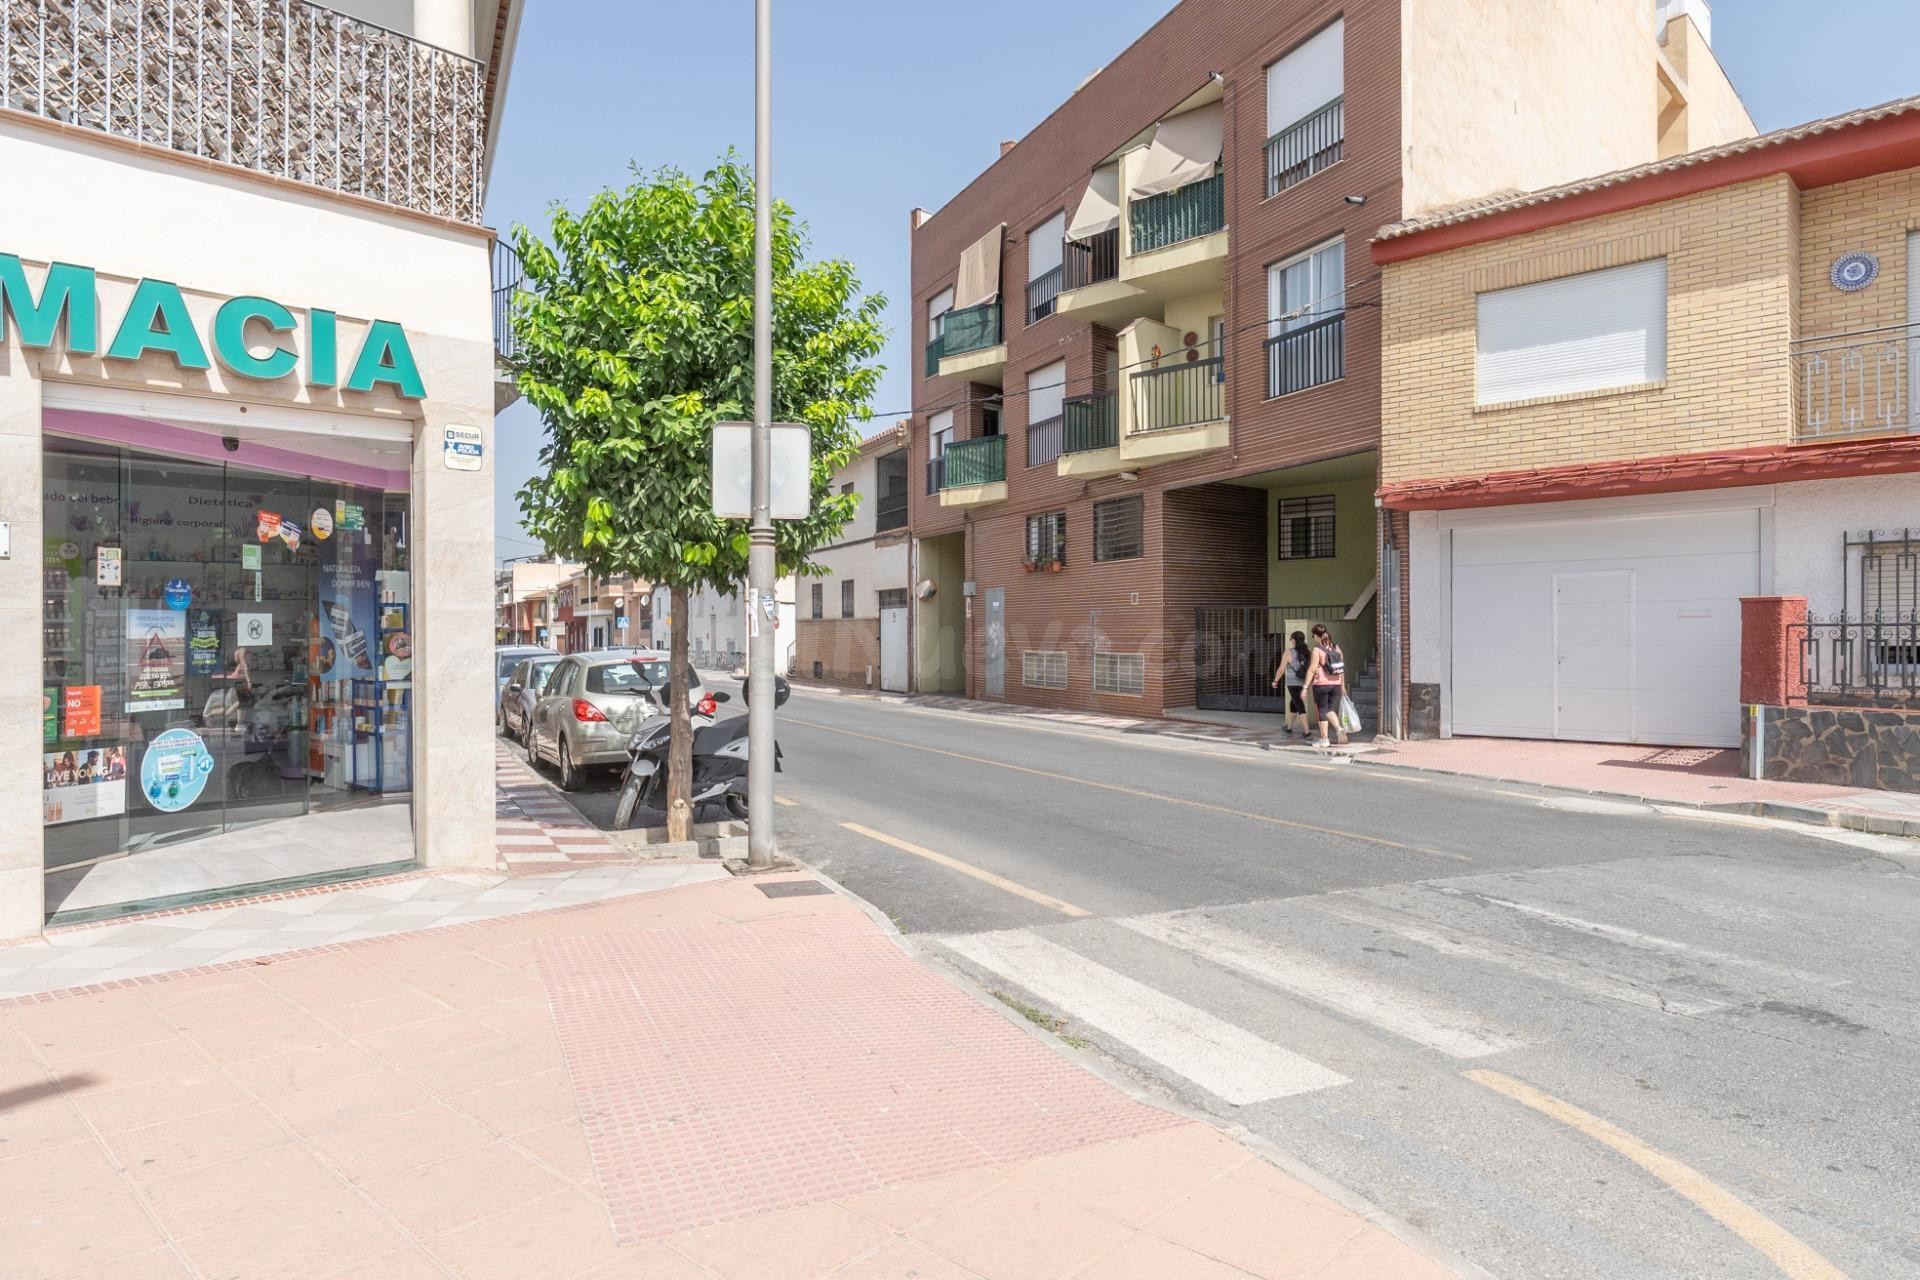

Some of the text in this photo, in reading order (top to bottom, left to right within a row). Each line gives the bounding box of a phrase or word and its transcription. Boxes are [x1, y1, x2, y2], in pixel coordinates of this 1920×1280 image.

[0, 252, 427, 398] MACIA
[176, 520, 225, 528] corporal
[67, 699, 81, 708] NO
[47, 766, 109, 783] LIVE YOUNG
